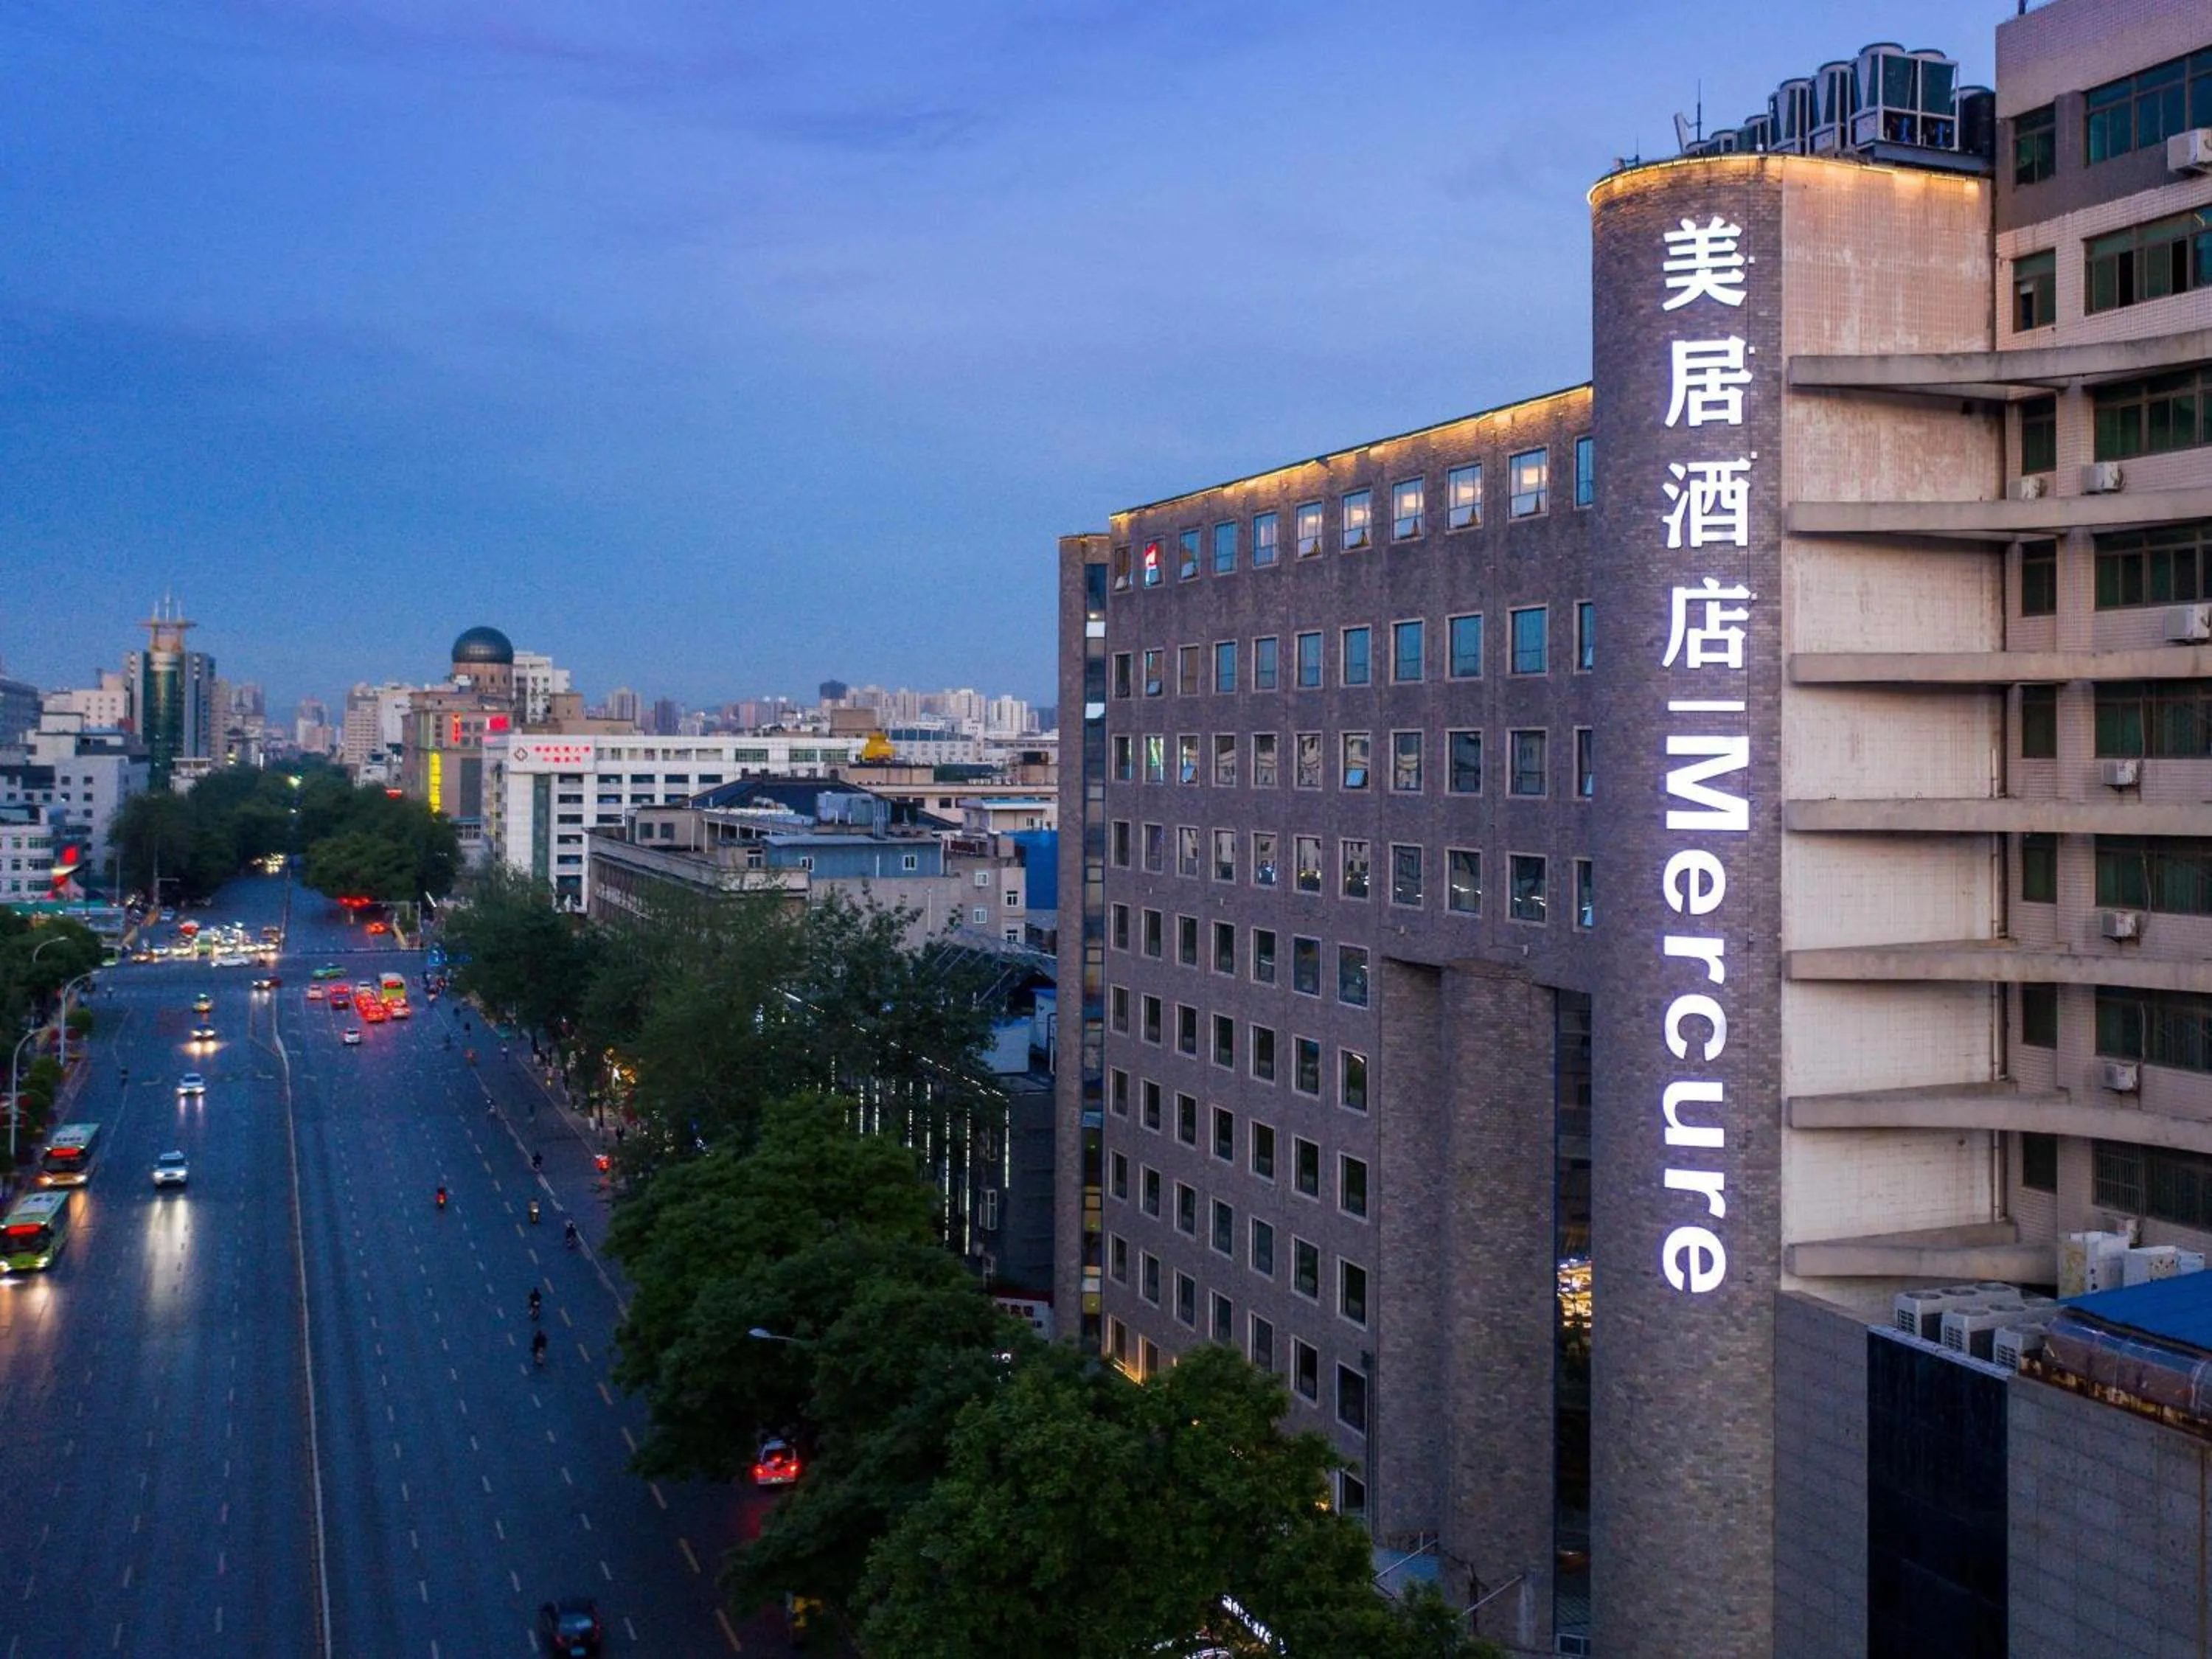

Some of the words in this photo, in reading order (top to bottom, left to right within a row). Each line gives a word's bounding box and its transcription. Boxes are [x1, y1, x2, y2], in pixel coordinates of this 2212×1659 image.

[1663, 216, 1752, 668] 美居酒店
[1663, 736, 1750, 1293] Mercure
